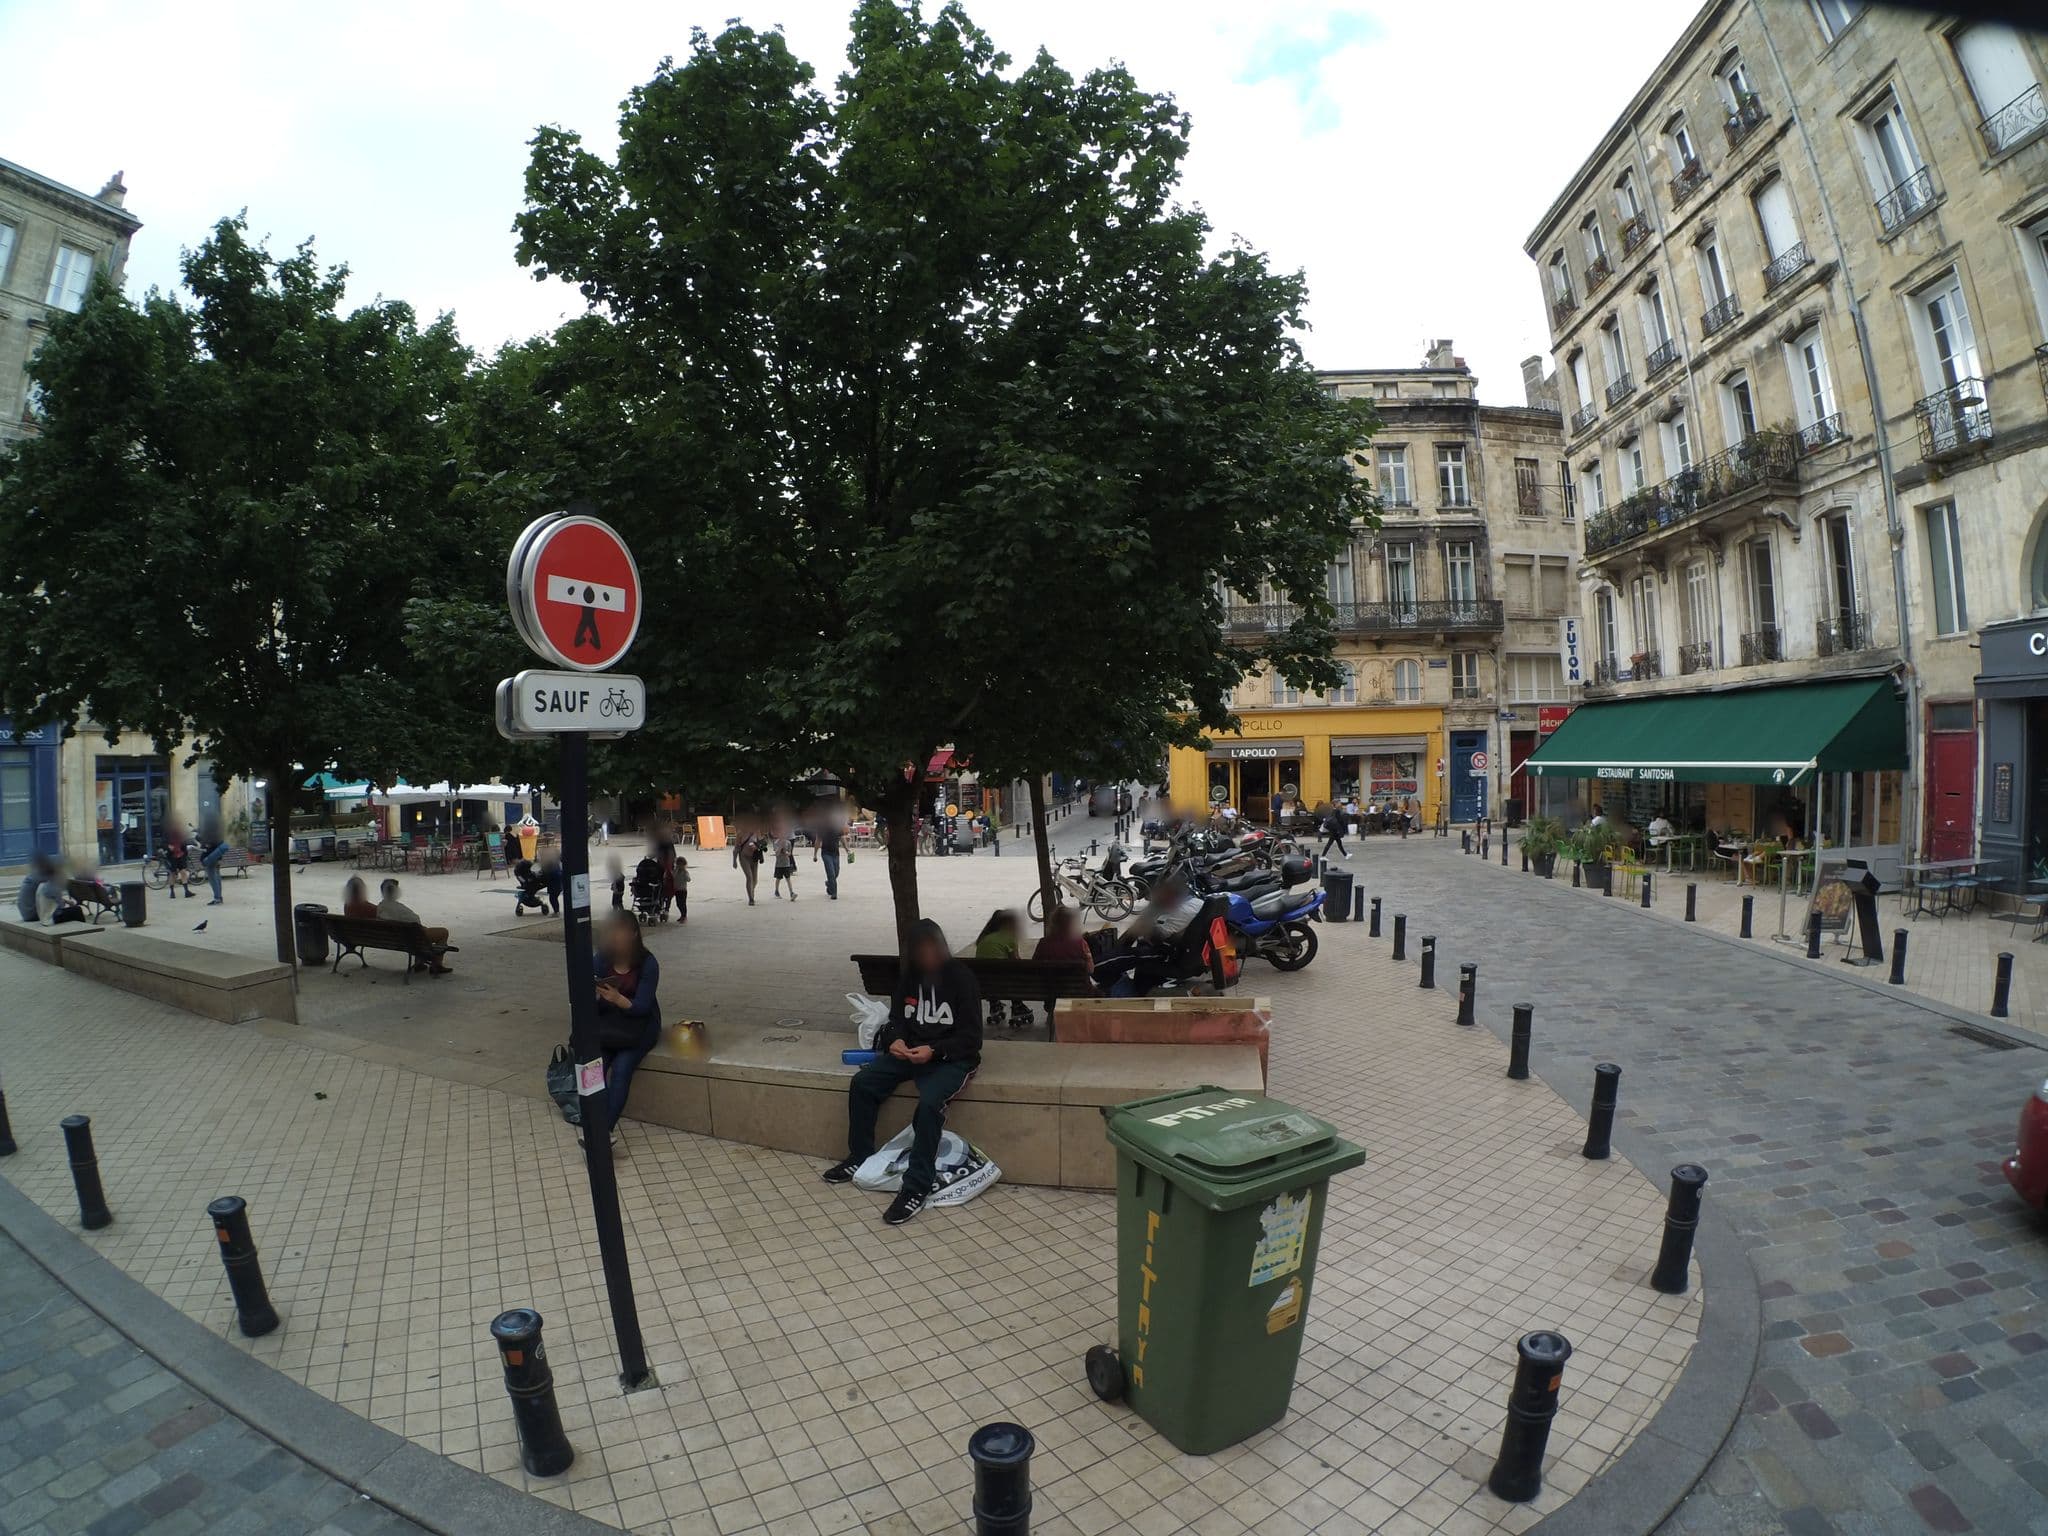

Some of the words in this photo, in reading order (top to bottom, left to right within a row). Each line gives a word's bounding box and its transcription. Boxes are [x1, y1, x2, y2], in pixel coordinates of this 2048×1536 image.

[1566, 620, 1579, 680] FUTON
[534, 689, 590, 713] SAUF
[1241, 719, 1283, 731] POLLO
[1231, 748, 1277, 758] L'APOLLO
[1597, 768, 1634, 779] RESTAURANT
[1639, 768, 1674, 780] SANTOSHA
[904, 995, 954, 1026] FILA
